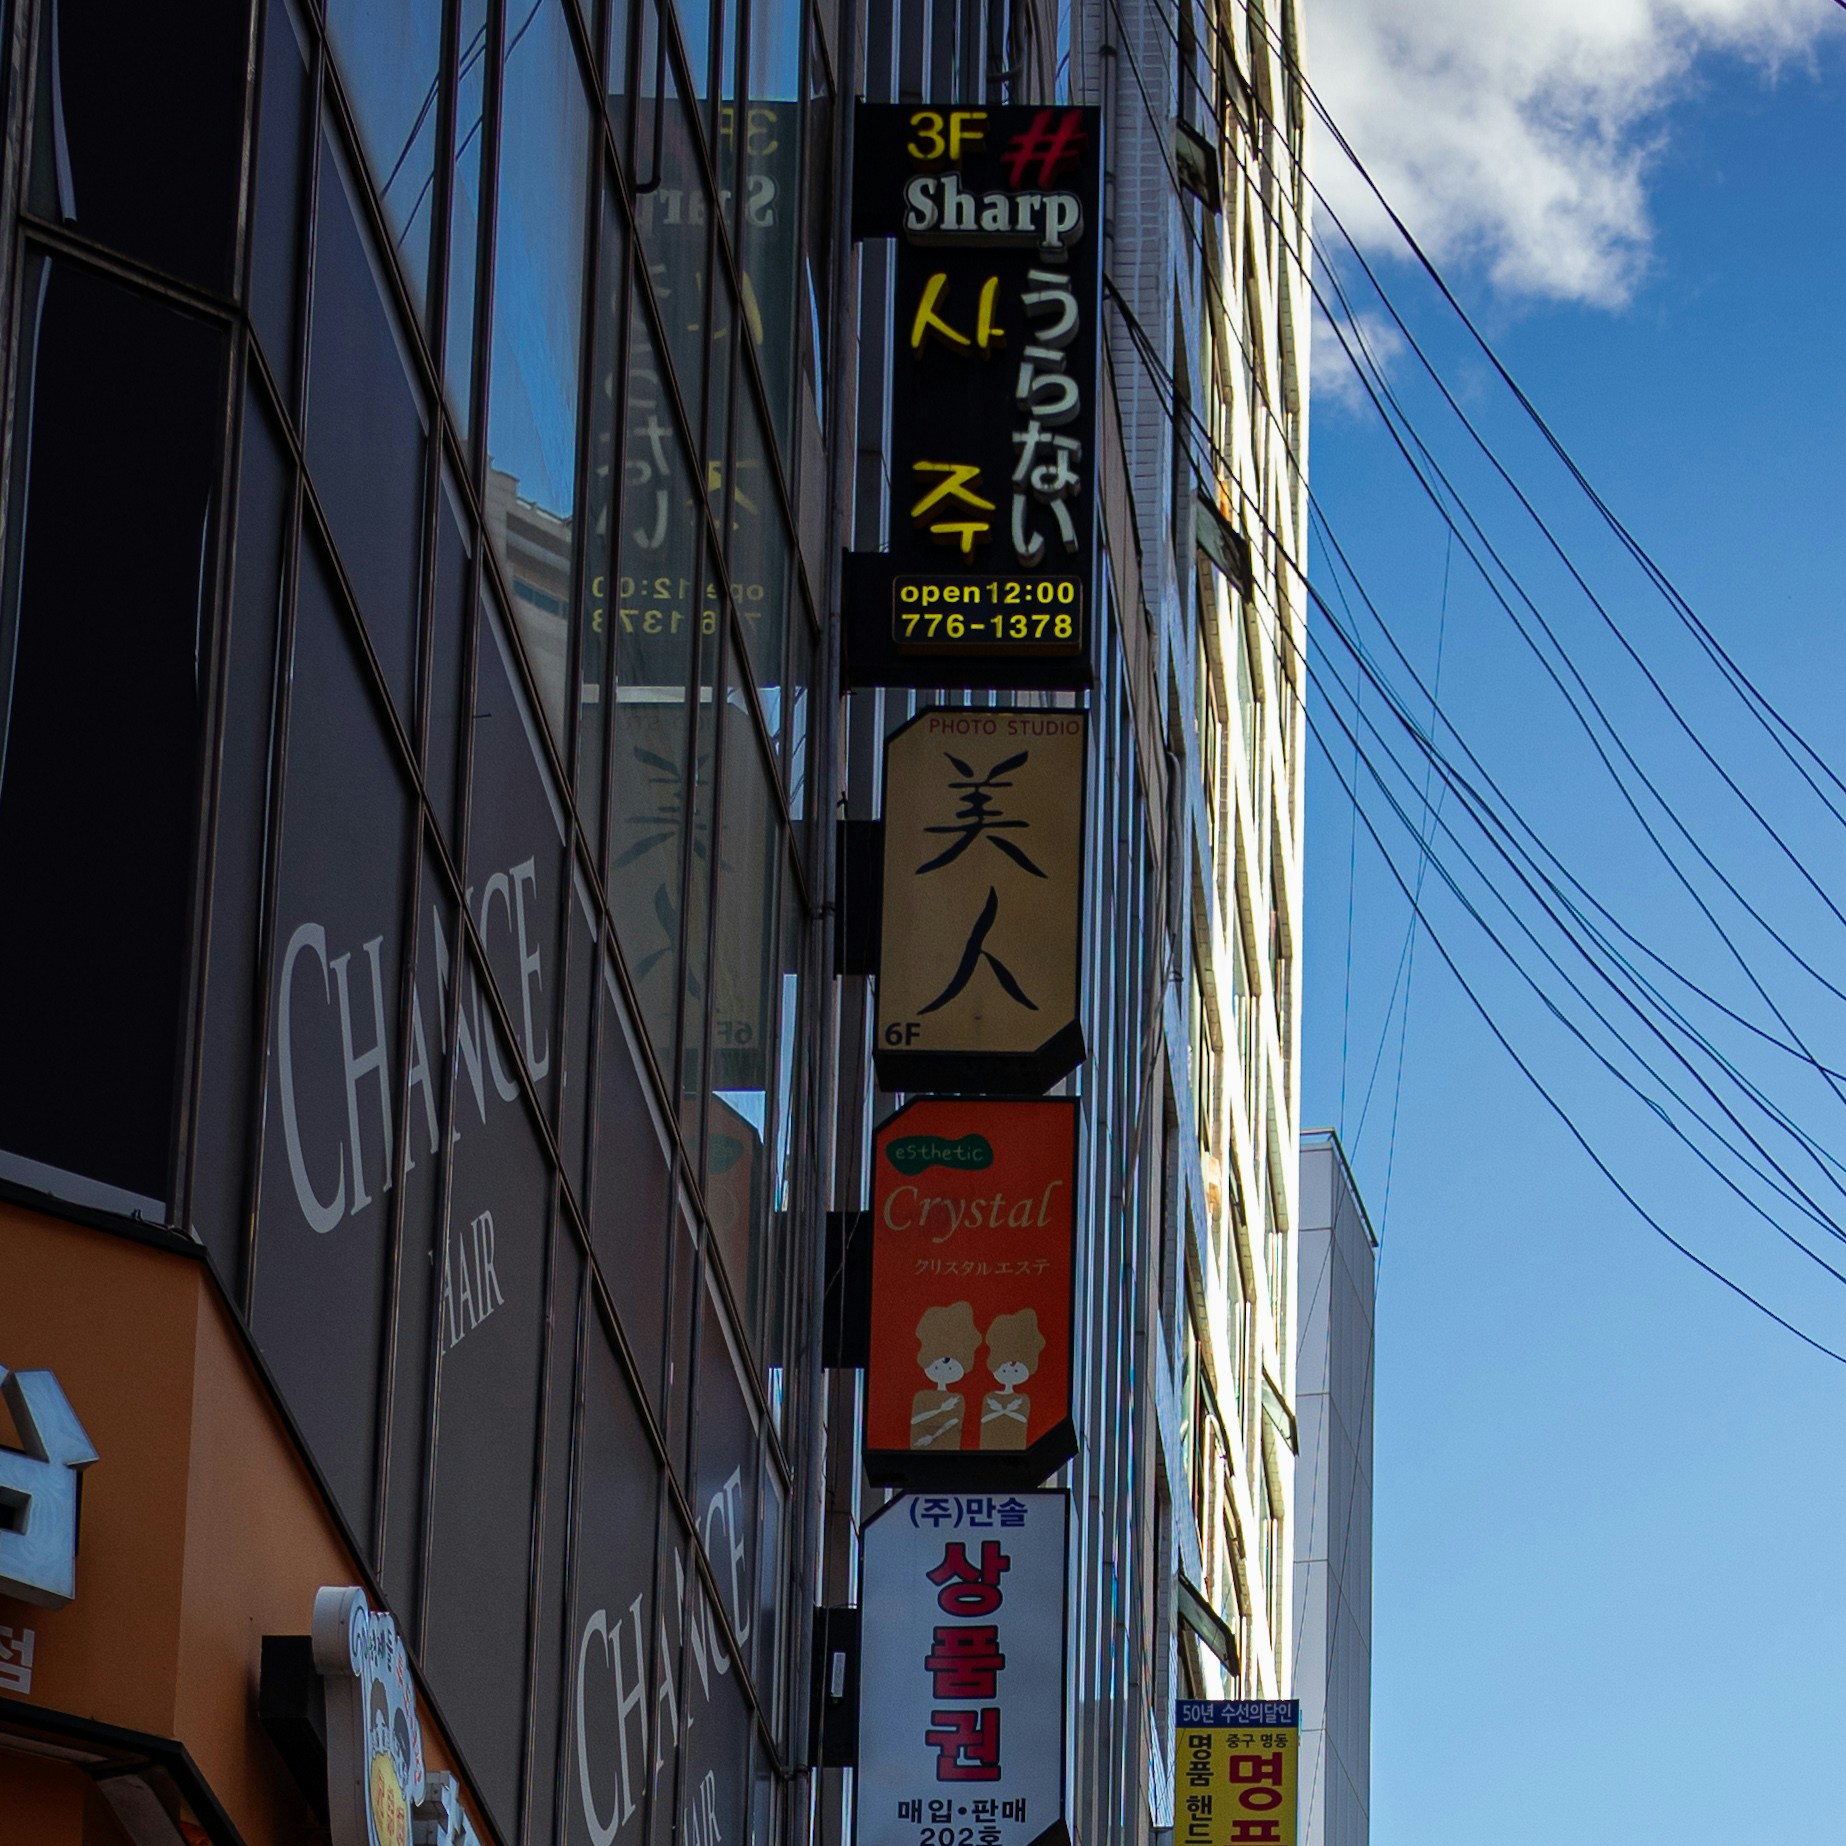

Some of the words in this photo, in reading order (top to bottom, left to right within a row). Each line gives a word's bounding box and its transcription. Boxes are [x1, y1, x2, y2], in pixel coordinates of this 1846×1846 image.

[907, 111, 988, 162] 3F
[906, 174, 1082, 249] Sharp
[911, 272, 1005, 556] 사주
[1012, 268, 1081, 566] うらない
[901, 614, 1073, 639] 776-1378
[930, 719, 996, 735] PHOTO
[1008, 719, 1080, 737] STUDIO
[915, 750, 1049, 1016] 美人
[277, 855, 549, 1236] CHANCE
[885, 1023, 921, 1047] 6F
[895, 1143, 984, 1164] esthetic
[883, 1179, 1062, 1247] Crystal
[908, 1495, 1029, 1529] (주)만솔
[924, 1540, 1010, 1783] 상품권
[1182, 1703, 1215, 1724] 50년
[1221, 1703, 1292, 1724] 수선의달인
[1186, 1734, 1214, 1787] 명품
[1226, 1734, 1256, 1748] 중구
[1260, 1733, 1288, 1748] 명동
